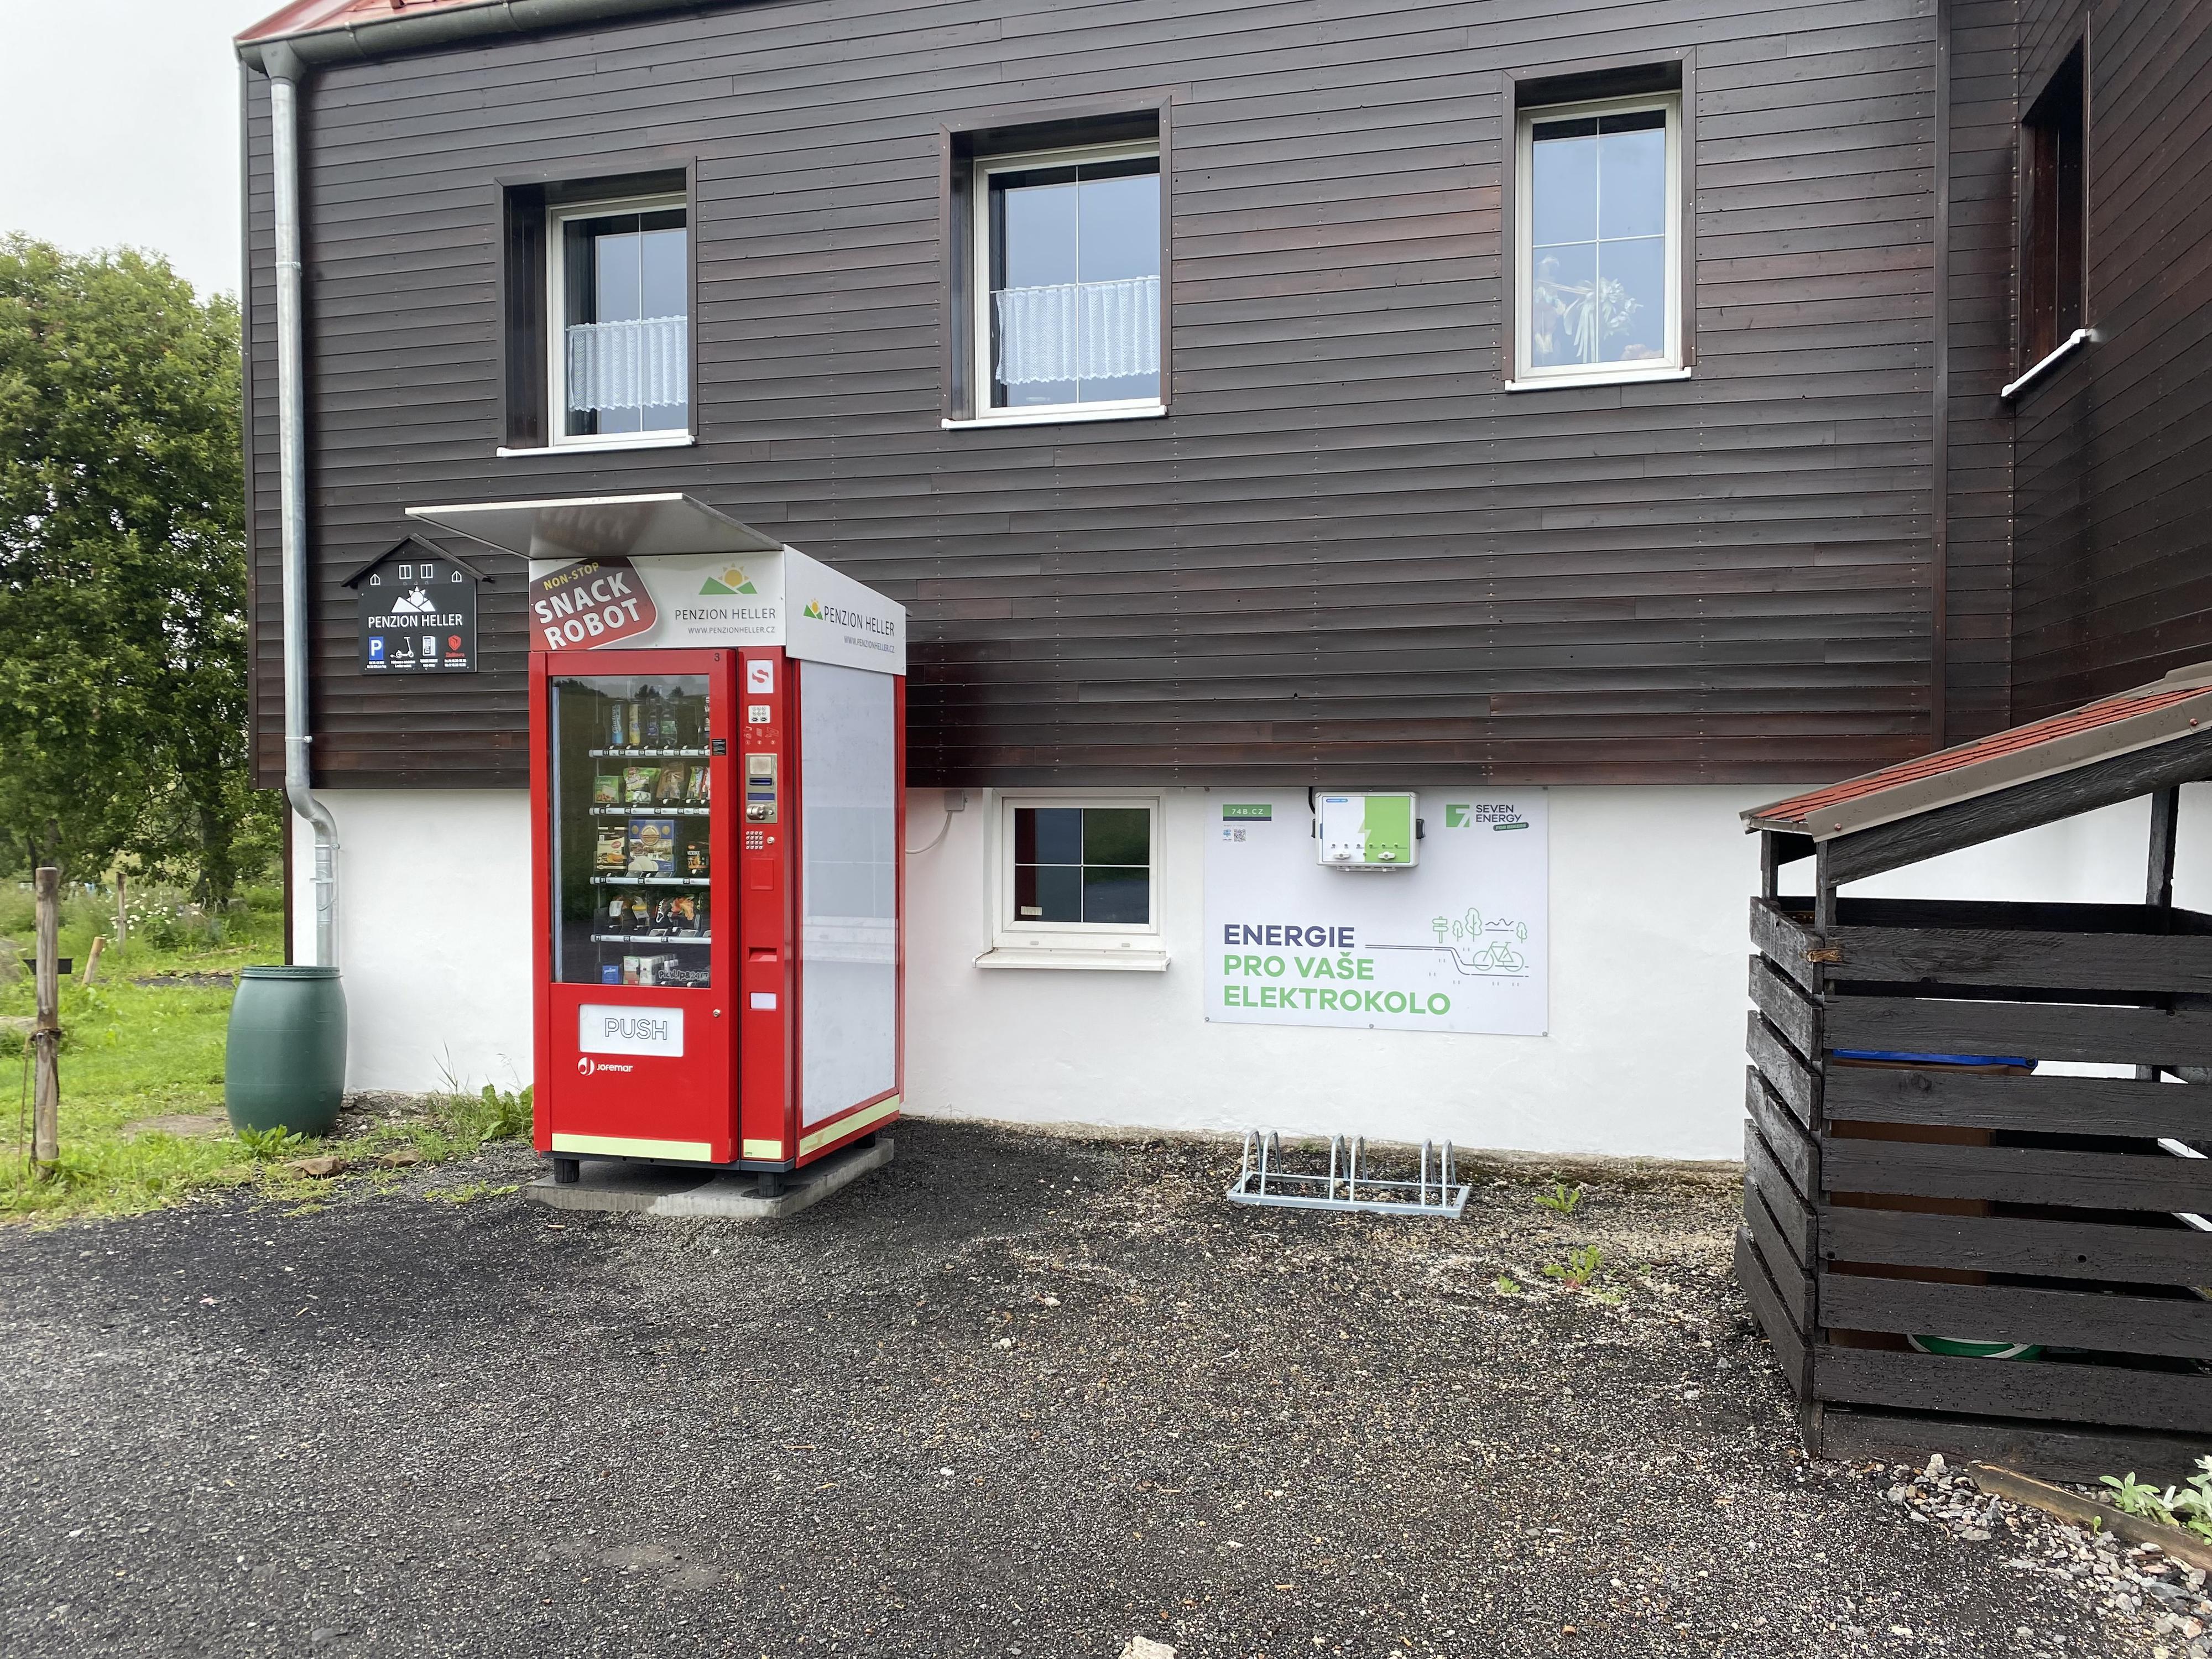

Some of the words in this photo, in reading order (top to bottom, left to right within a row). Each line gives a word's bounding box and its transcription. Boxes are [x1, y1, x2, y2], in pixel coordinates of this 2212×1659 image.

[543, 562, 599, 591] NON-STOP
[534, 571, 632, 624] SNACK
[368, 614, 418, 628] PENZION
[421, 613, 463, 627] HELLER
[543, 597, 640, 650] ROBOT
[675, 609, 727, 620] PENZION
[732, 608, 776, 619] HELLER
[824, 606, 863, 629] PENZION
[865, 616, 895, 637] HELLER
[688, 626, 776, 634] WWW.PENZIONHELLER.CZ
[844, 635, 895, 653] WWW.PENZIONHELLER.CZ
[714, 652, 720, 662] 3
[1475, 804, 1514, 813] SEVEN
[1475, 814, 1522, 822] ENERGY
[1224, 924, 1355, 948] ENERGIE
[1224, 954, 1286, 977] PRO
[1294, 952, 1374, 980] VAŠE
[1224, 985, 1451, 1015] ELEKTROKOLO
[604, 1018, 667, 1040] PUSH
